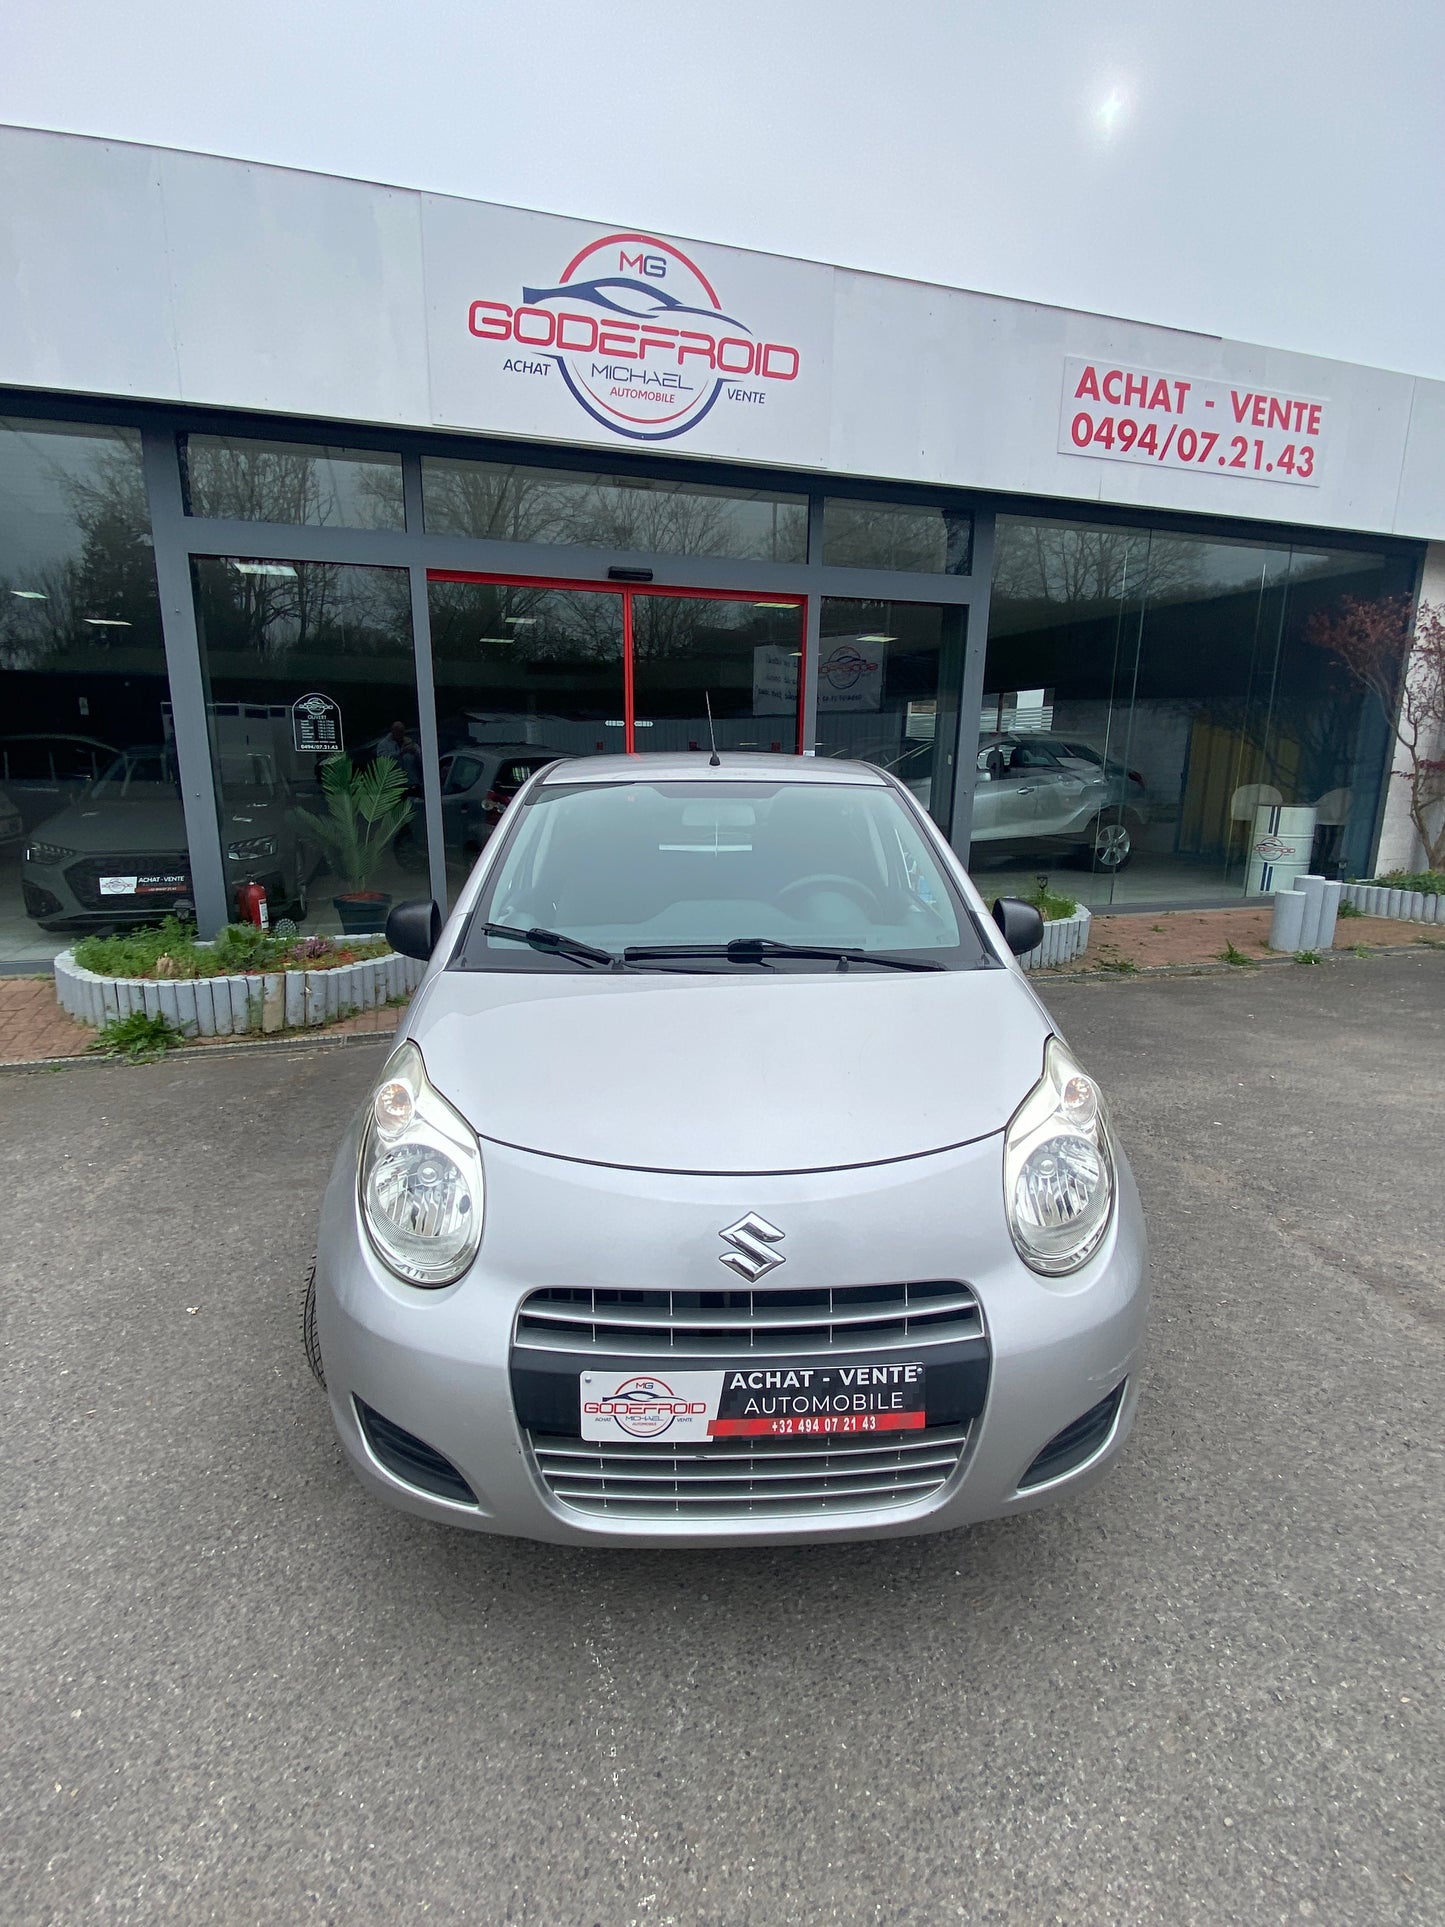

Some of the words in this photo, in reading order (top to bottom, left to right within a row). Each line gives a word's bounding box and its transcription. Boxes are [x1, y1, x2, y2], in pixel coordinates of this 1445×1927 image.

[619, 250, 667, 278] MG
[468, 300, 800, 381] GODEFROID
[503, 359, 551, 377] ACHAT
[591, 363, 694, 391] MICHAEL
[609, 386, 675, 404] AUTOMOBILE
[727, 388, 766, 405] VENTE
[1074, 366, 1191, 414] ACHAT
[1230, 390, 1322, 435] VENTE
[1071, 412, 1314, 478] 0494/07.21.43
[730, 1370, 814, 1390] ACHAT
[839, 1366, 917, 1386] VENTE
[584, 1402, 706, 1415] GODEFROID
[744, 1392, 903, 1415] AUTOMOBILE
[772, 1419, 793, 1433] +32
[798, 1418, 819, 1433] 494
[824, 1417, 838, 1432] 07
[843, 1416, 857, 1431] 21
[862, 1416, 876, 1430] 43
